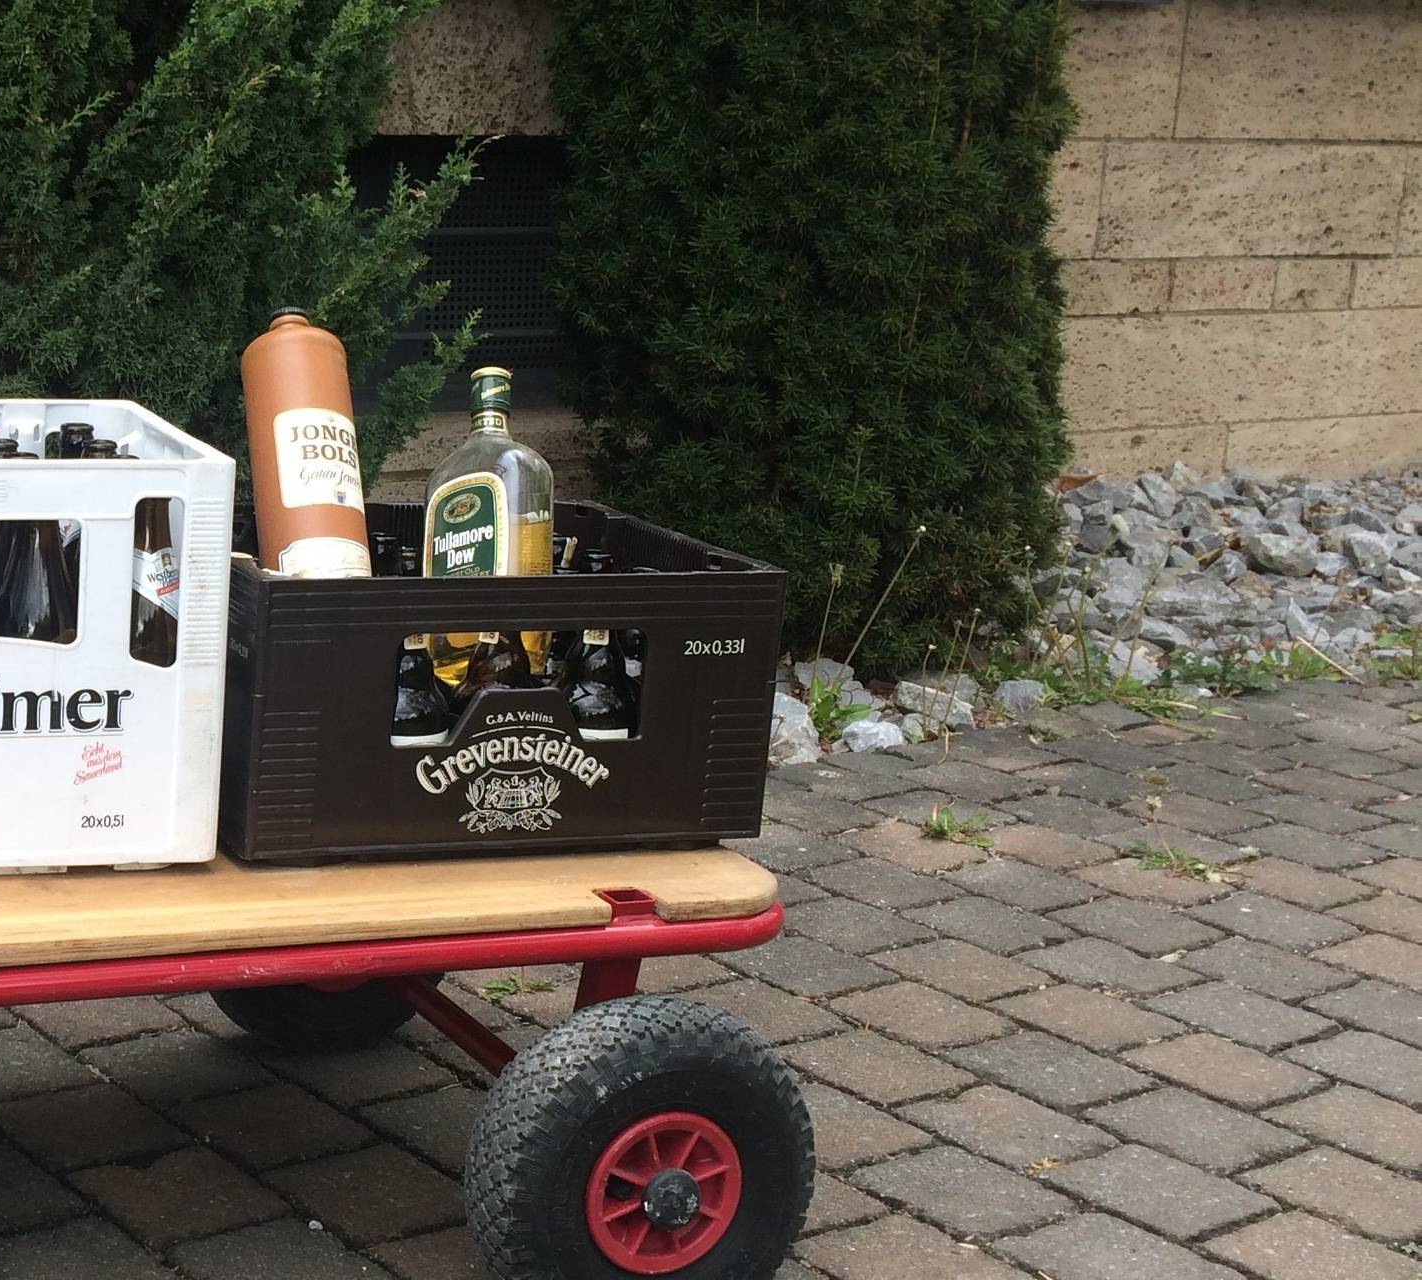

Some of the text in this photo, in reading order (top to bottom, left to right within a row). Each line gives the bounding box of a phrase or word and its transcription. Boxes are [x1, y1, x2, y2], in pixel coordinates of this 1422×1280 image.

[301, 444, 357, 470] BOLS
[433, 524, 494, 556] Tullamore
[446, 547, 476, 569] Dew
[684, 638, 746, 657] 20x0,33l
[517, 711, 554, 724] Veltins
[81, 741, 104, 761] Echt
[415, 733, 610, 795] Grevensteiner
[81, 814, 125, 829] 20x0,5l
